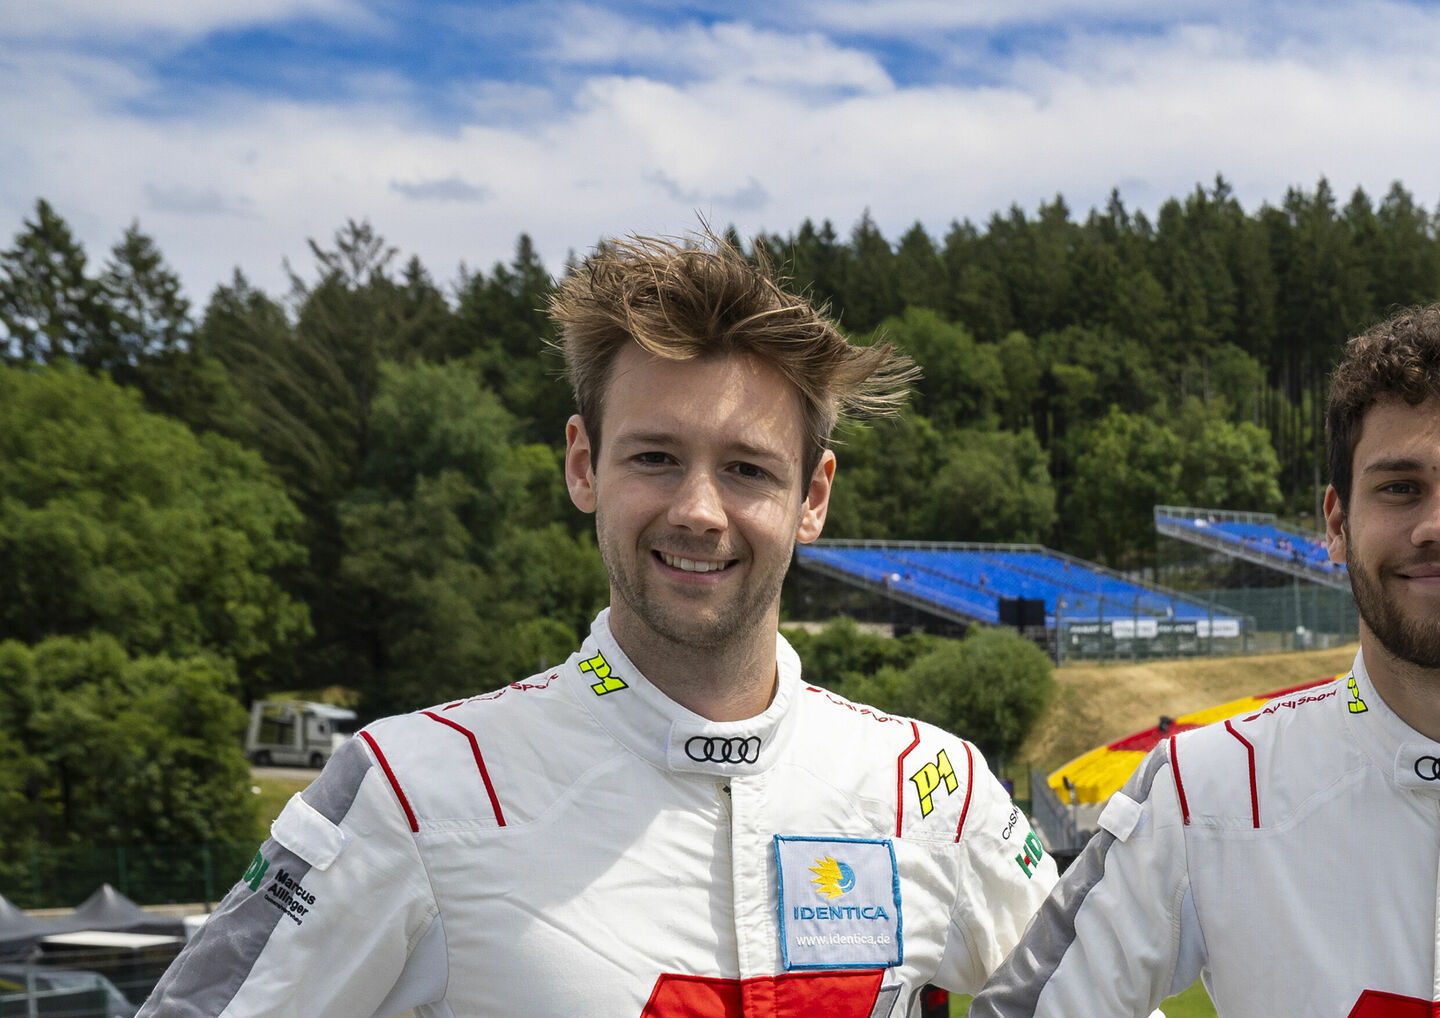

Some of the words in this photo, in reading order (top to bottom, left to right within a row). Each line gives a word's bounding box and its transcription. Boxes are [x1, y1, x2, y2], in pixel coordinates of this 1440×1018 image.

[909, 748, 959, 819] P1
[275, 869, 317, 905] Marcus
[793, 905, 890, 921] IDENTICA
[795, 932, 891, 947] www.identica.de
